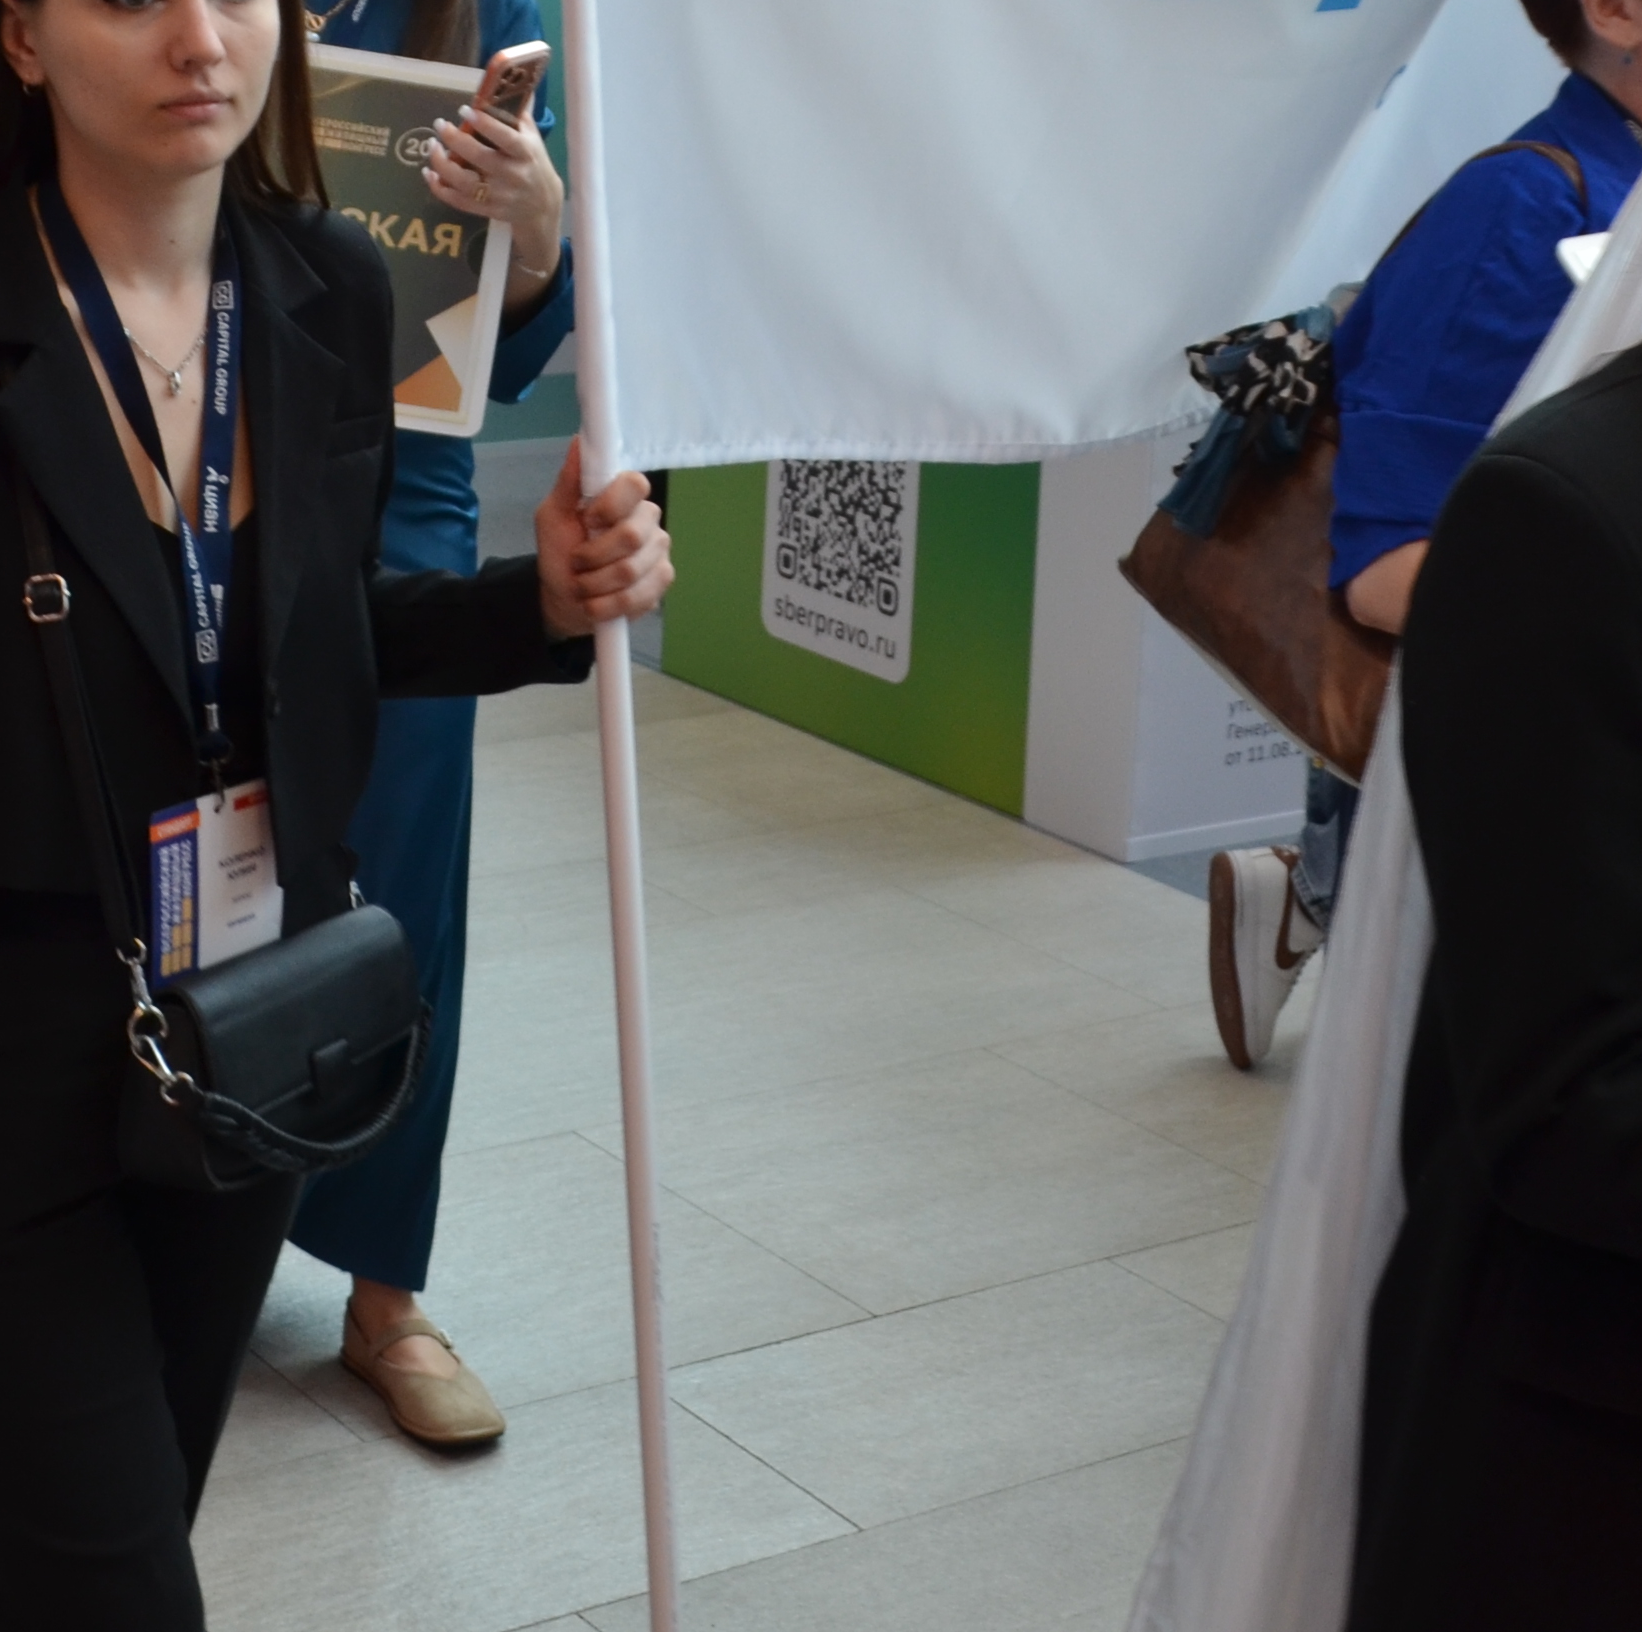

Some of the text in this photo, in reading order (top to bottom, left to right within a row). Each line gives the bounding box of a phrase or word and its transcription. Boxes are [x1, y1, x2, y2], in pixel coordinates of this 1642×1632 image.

[215, 311, 230, 365] CAPITAL
[213, 367, 228, 415] GROUP
[191, 569, 210, 629] CAPITAL
[773, 594, 897, 660] sberpravo.ru
[1247, 740, 1303, 763] 11.08.
